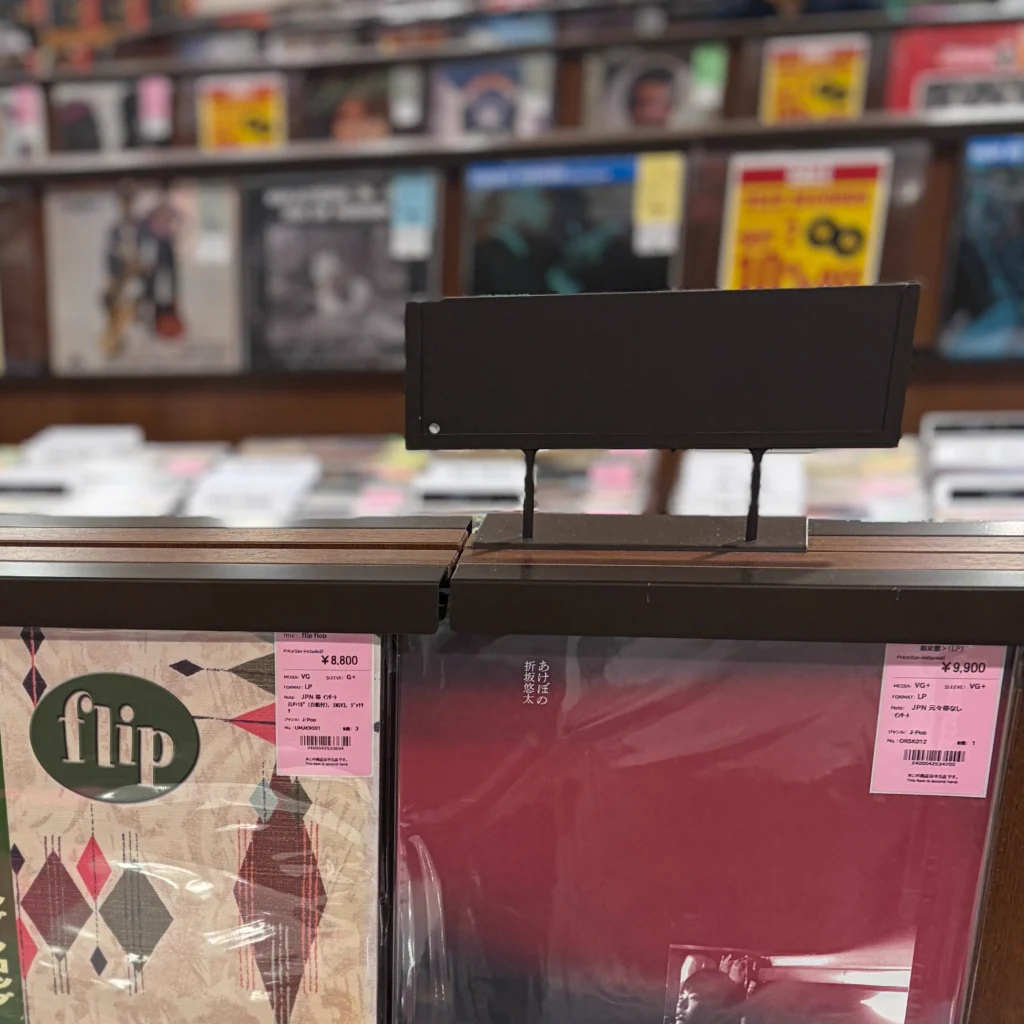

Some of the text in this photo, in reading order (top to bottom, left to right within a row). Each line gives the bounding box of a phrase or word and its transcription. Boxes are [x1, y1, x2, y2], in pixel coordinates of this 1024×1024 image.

[321, 655, 358, 665] ¥8,800
[522, 660, 536, 705] 折坂悠太
[536, 660, 550, 705] あけぼの
[942, 662, 986, 673] ¥9,900
[57, 690, 174, 786] flip
